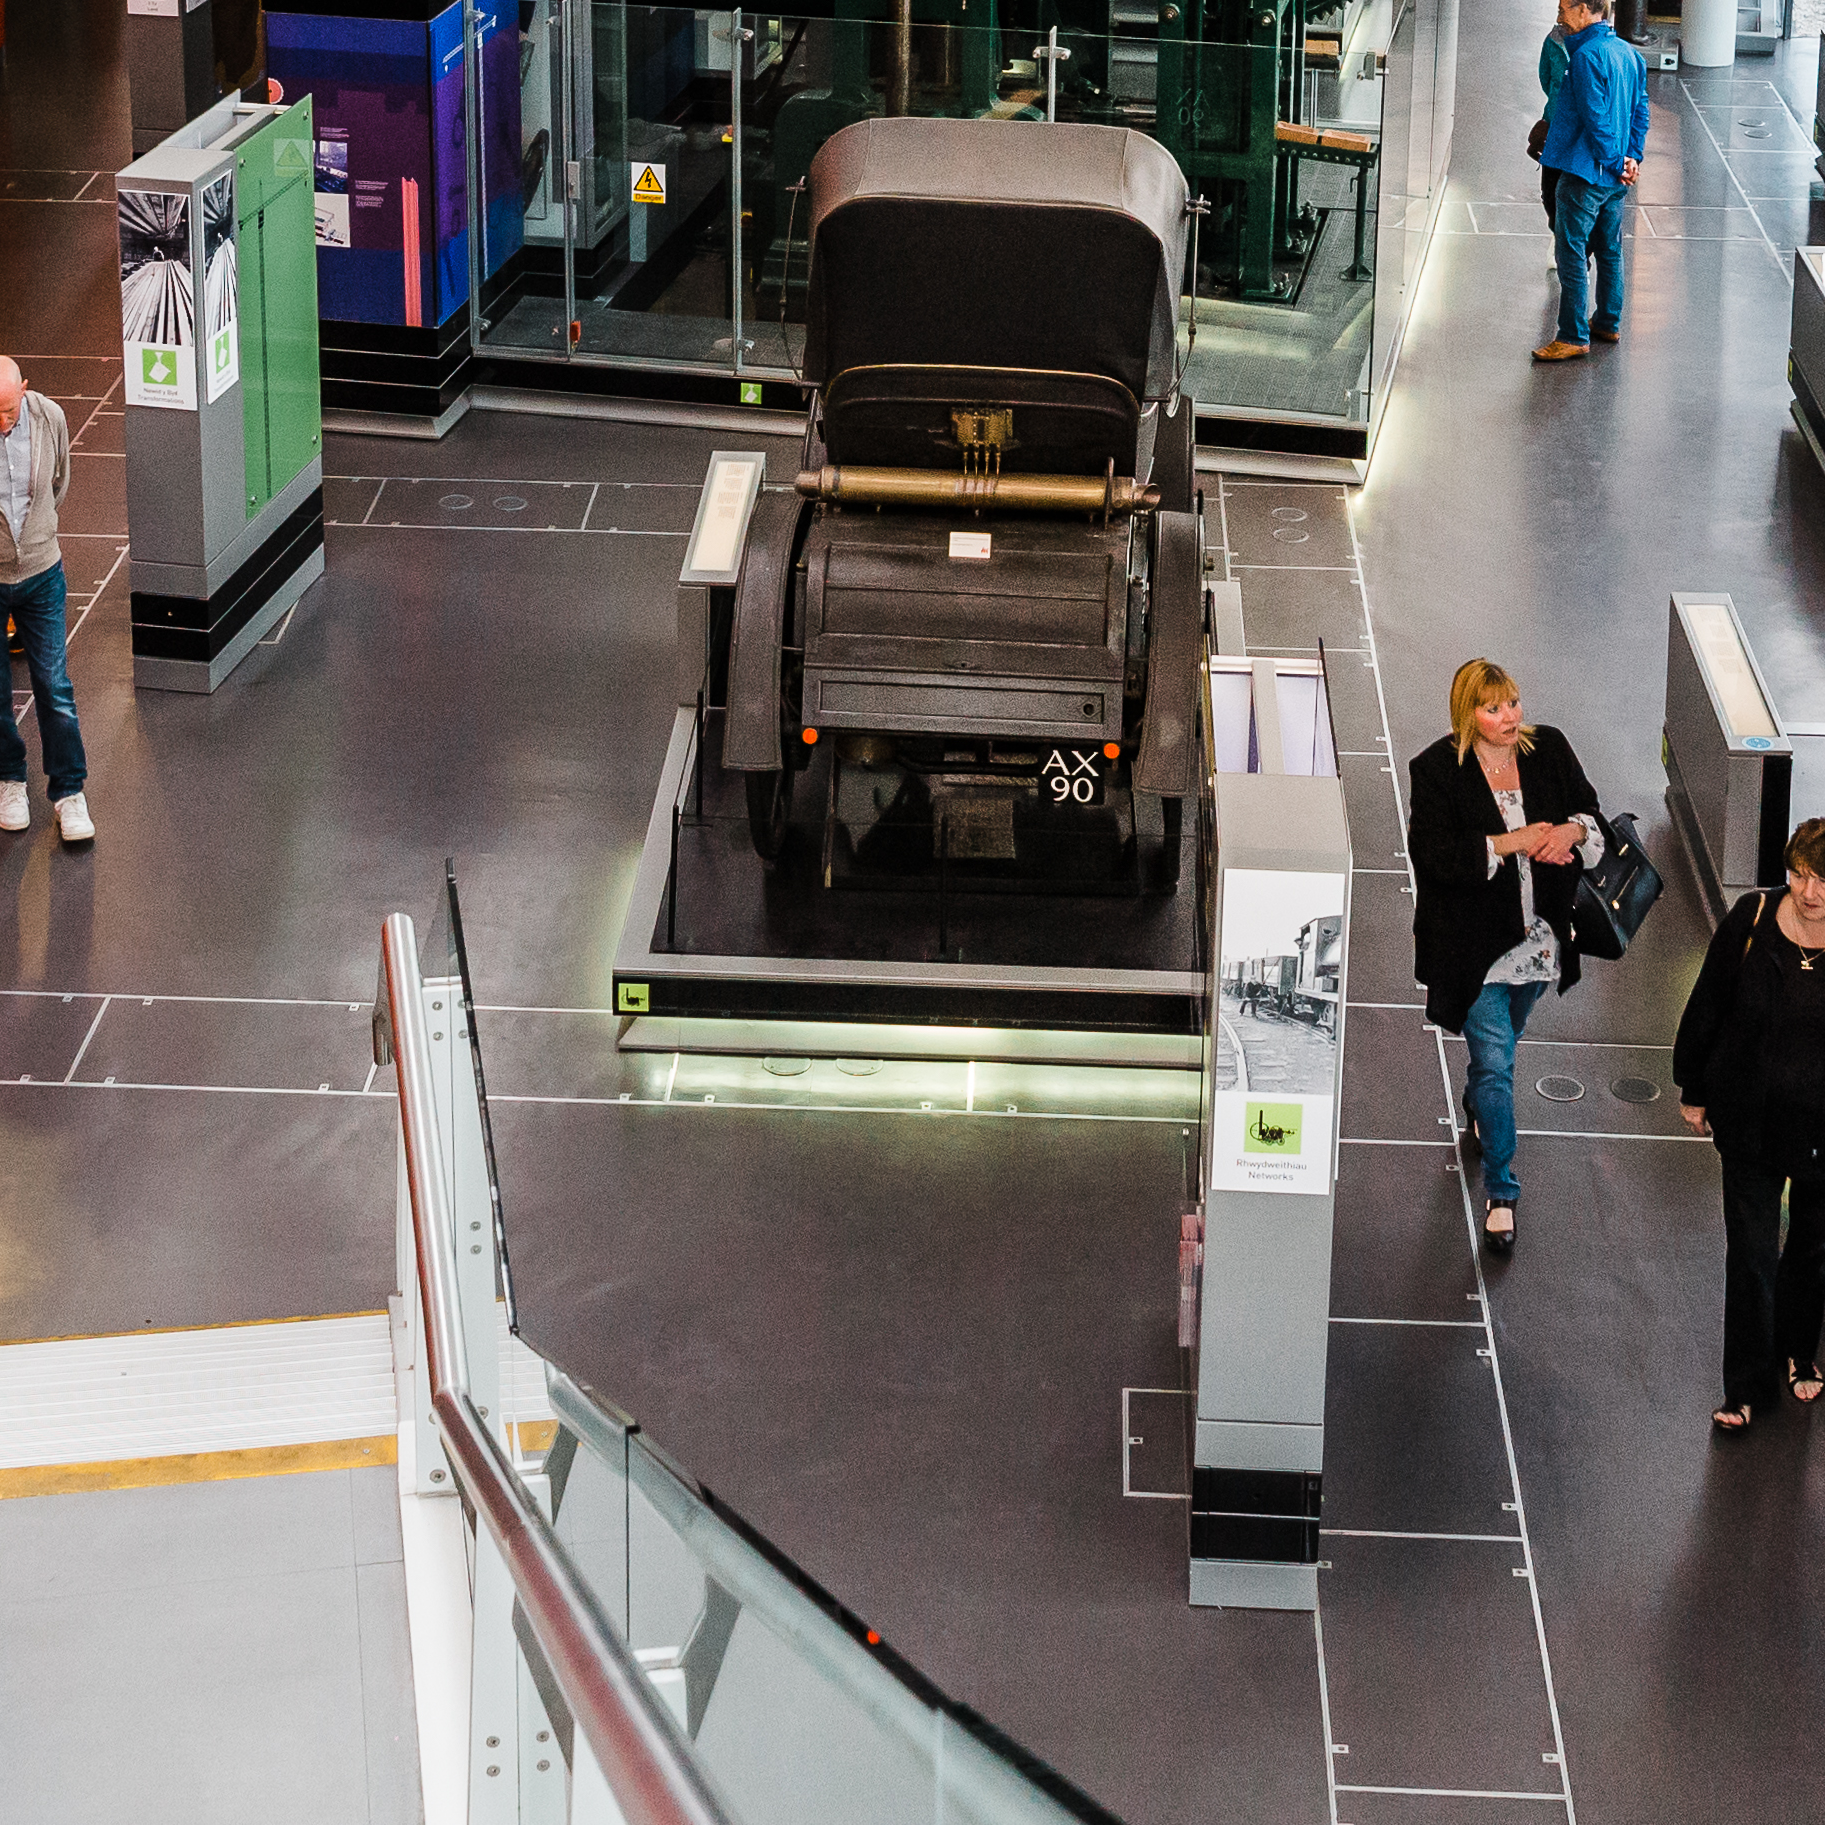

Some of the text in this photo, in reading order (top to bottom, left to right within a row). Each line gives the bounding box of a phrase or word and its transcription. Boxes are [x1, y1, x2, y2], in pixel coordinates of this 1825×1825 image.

[1041, 749, 1100, 777] AX
[1050, 775, 1094, 803] 90
[1236, 1158, 1307, 1170] Rhwydweithiau
[1248, 1171, 1294, 1181] Networks
